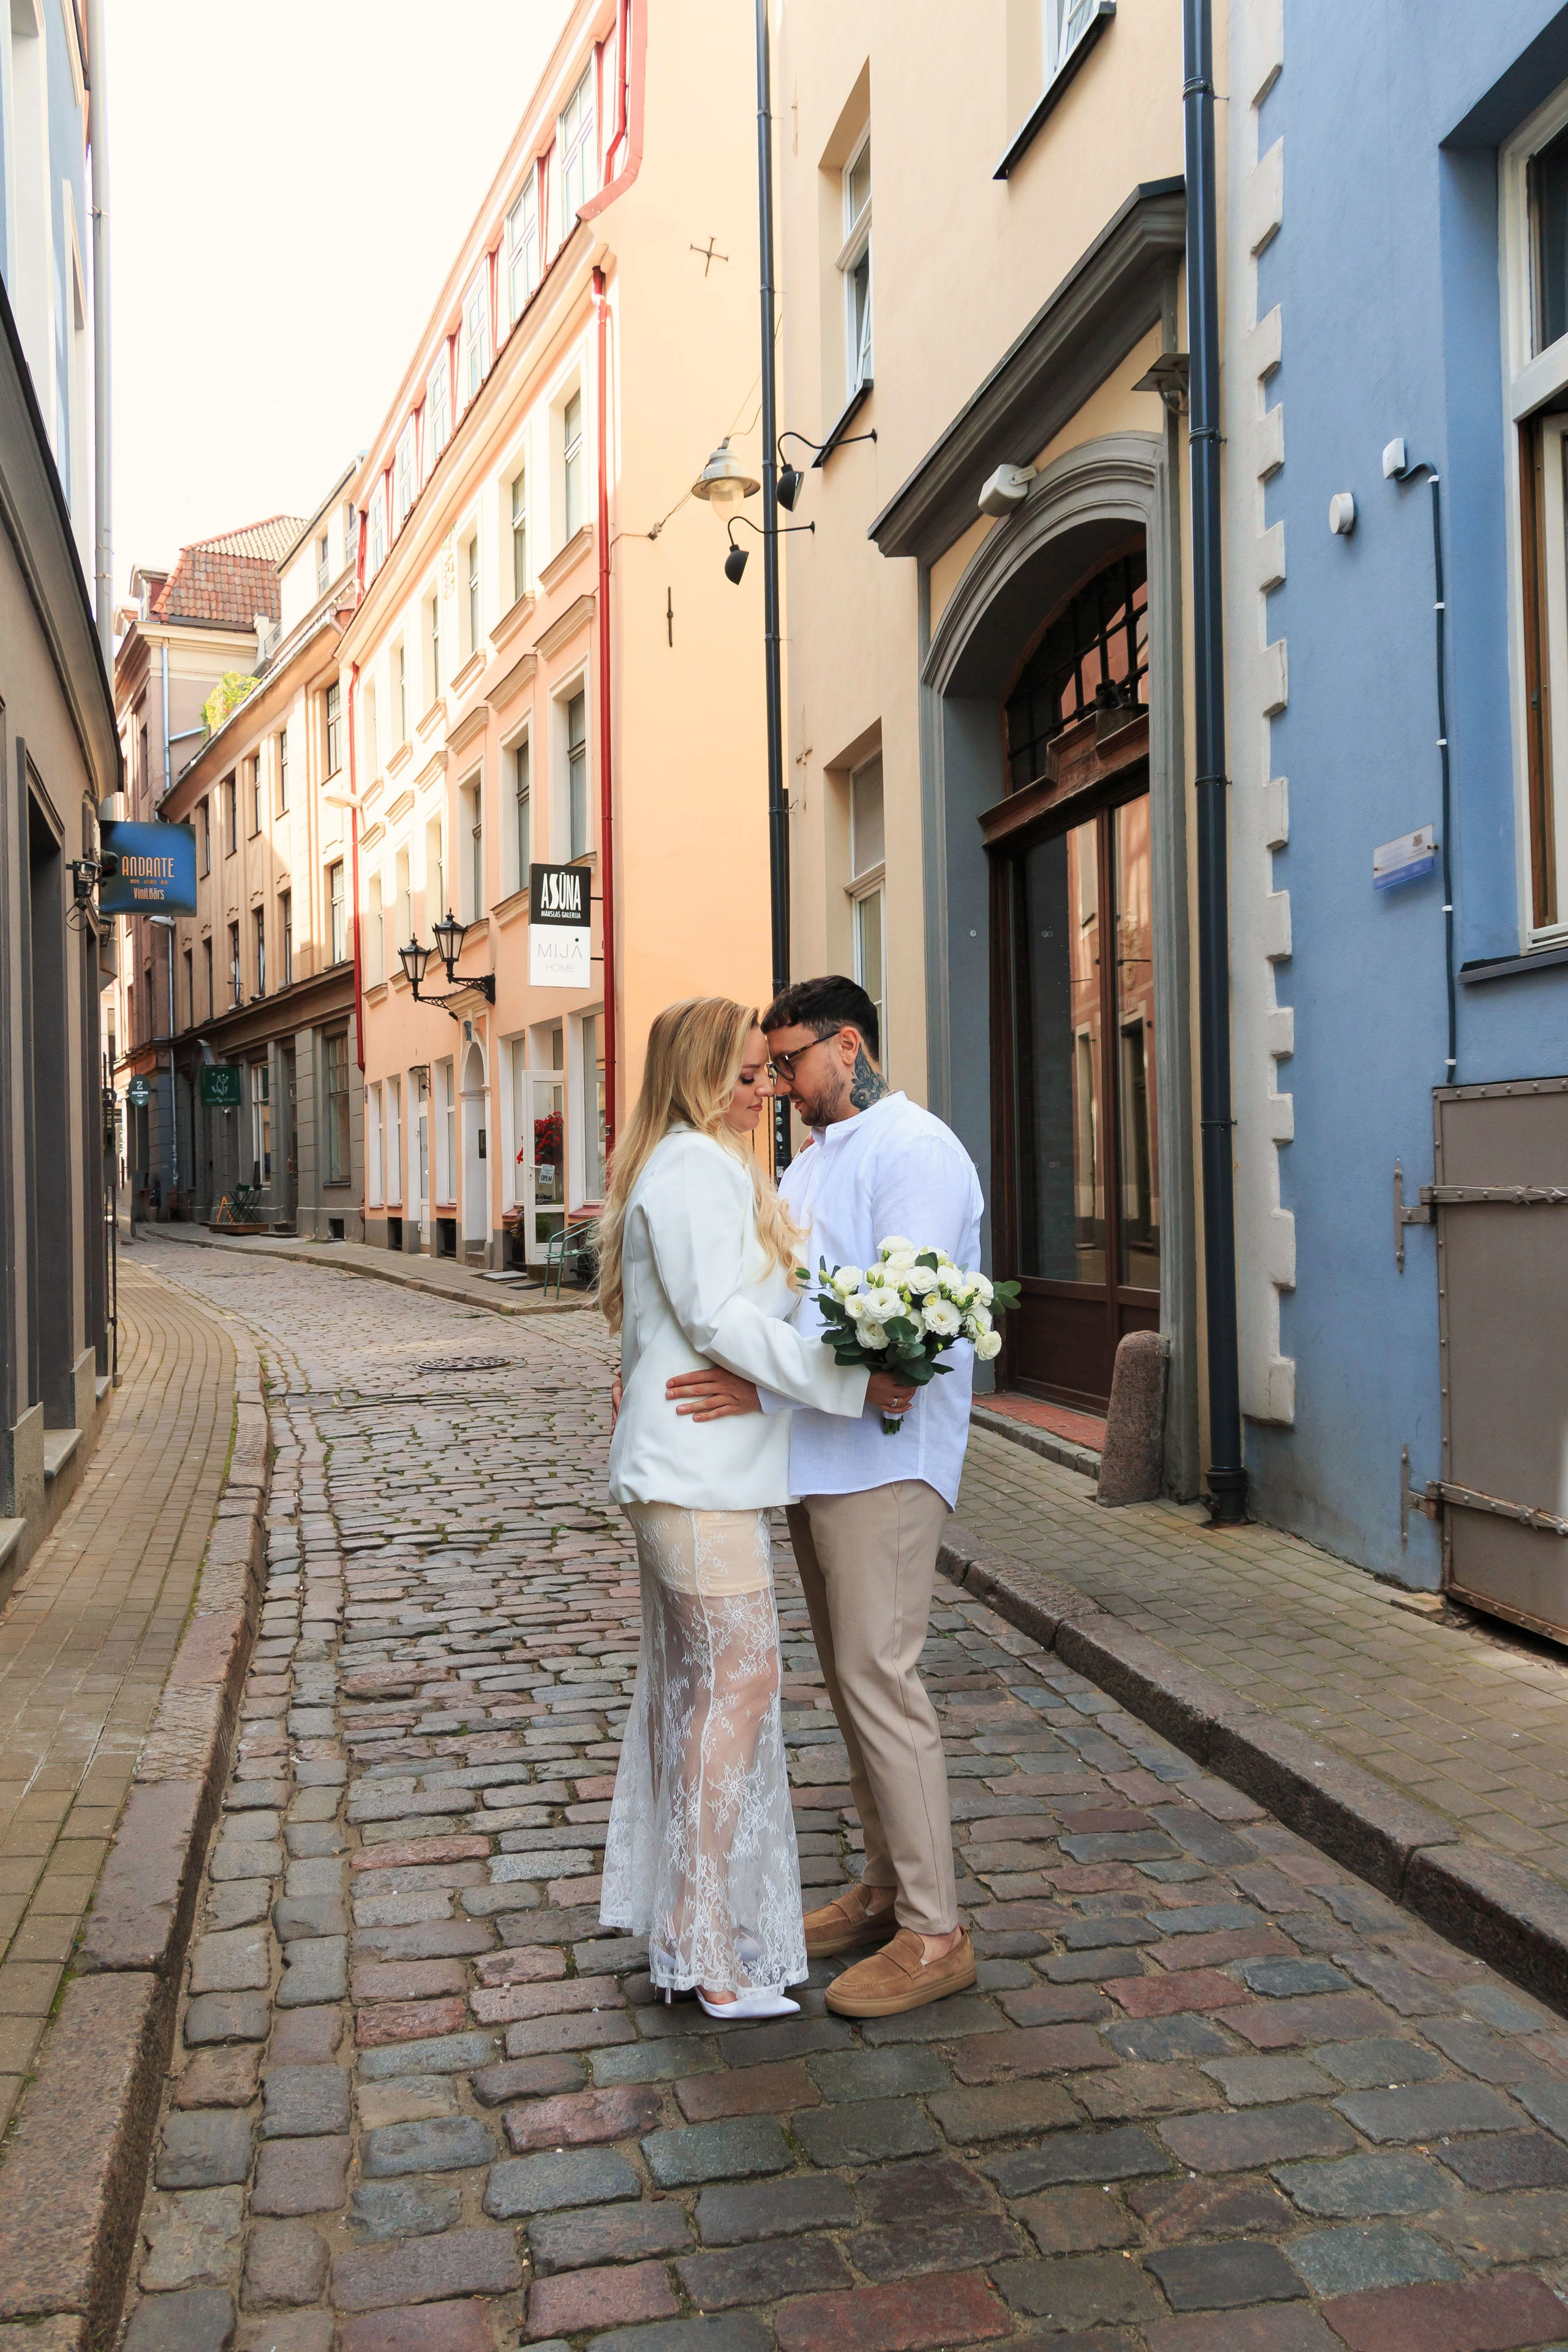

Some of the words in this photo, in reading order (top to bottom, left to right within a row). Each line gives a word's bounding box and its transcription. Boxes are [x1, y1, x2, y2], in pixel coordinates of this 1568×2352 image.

[122, 856, 175, 878] ANDANTE
[540, 872, 581, 911] ASŪNA
[561, 911, 581, 919] GALERIJA
[546, 963, 575, 973] HOME
[136, 1080, 143, 1090] Z
